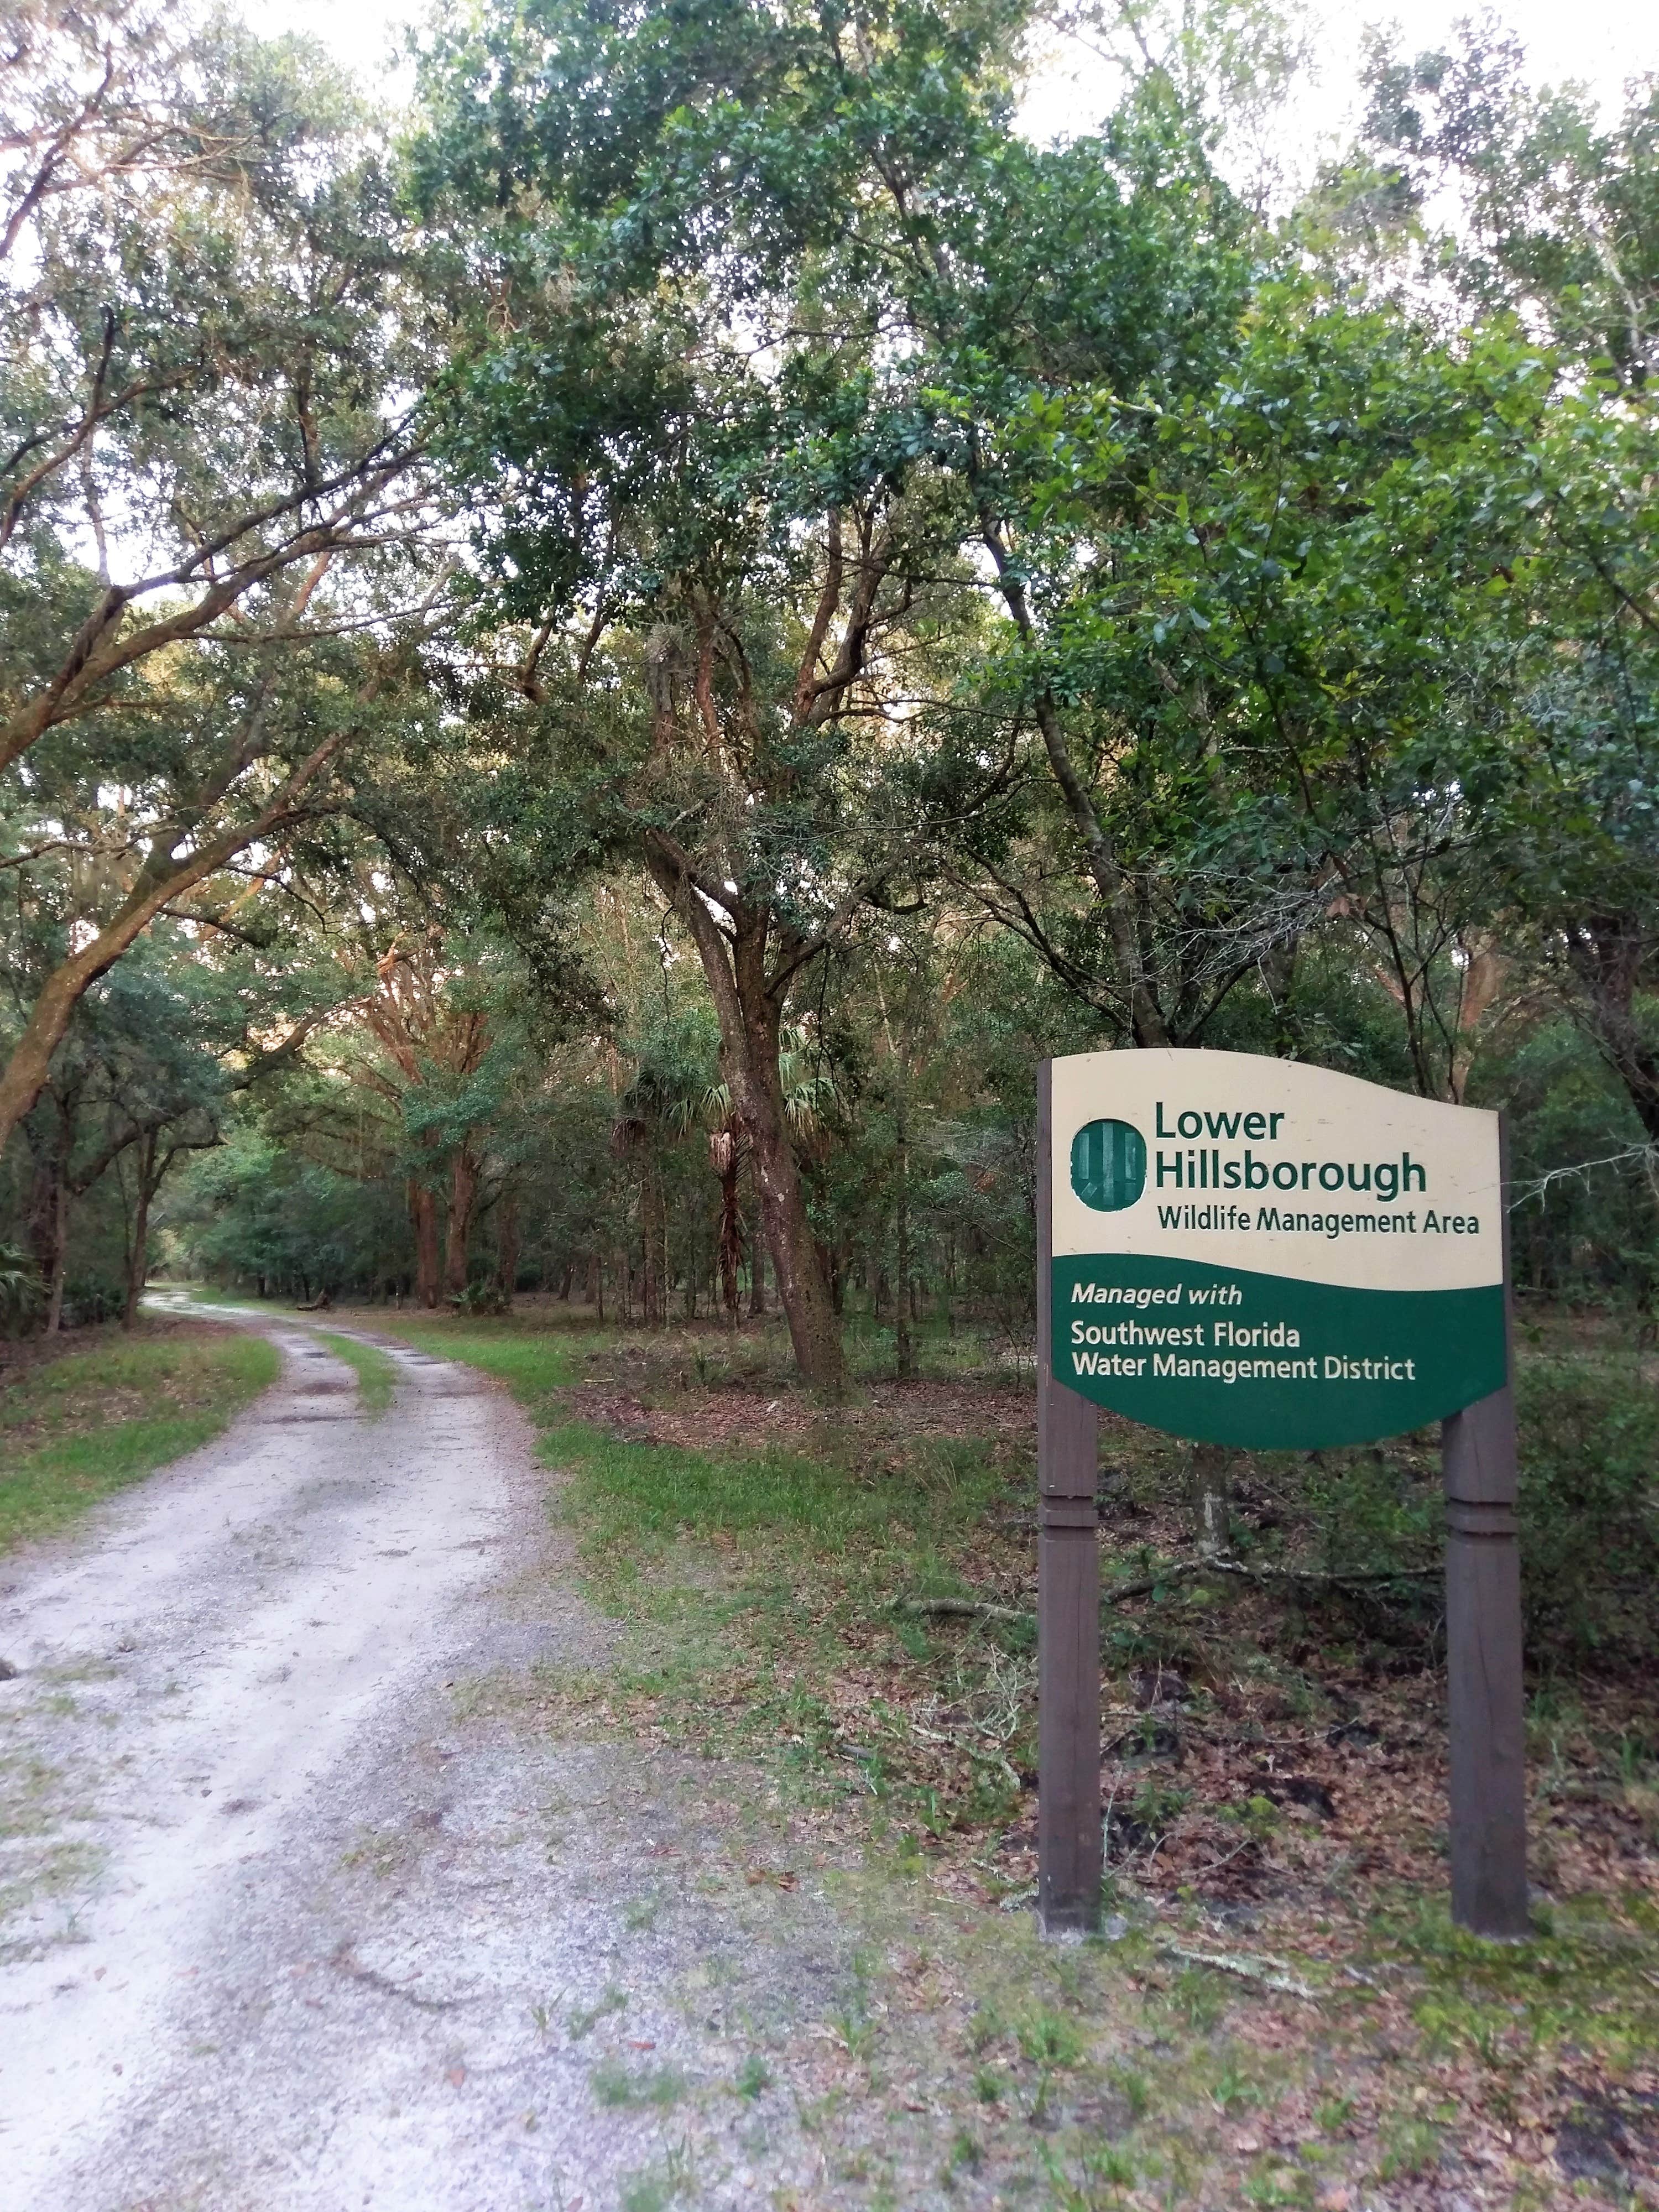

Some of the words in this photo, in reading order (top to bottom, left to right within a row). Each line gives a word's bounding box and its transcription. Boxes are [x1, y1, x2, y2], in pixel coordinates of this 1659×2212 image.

[1156, 1102, 1285, 1140] Lower
[1156, 1149, 1426, 1202] Hillsborough
[1157, 1204, 1251, 1230] Wildlife
[1256, 1207, 1417, 1239] Management
[1422, 1209, 1479, 1234] Area
[1071, 1283, 1182, 1309] Managed
[1188, 1284, 1242, 1305] with
[1071, 1319, 1205, 1346] Southwest
[1214, 1321, 1300, 1348] Florida
[1072, 1352, 1147, 1376] Water
[1153, 1353, 1318, 1384] Management
[1324, 1355, 1416, 1380] District
